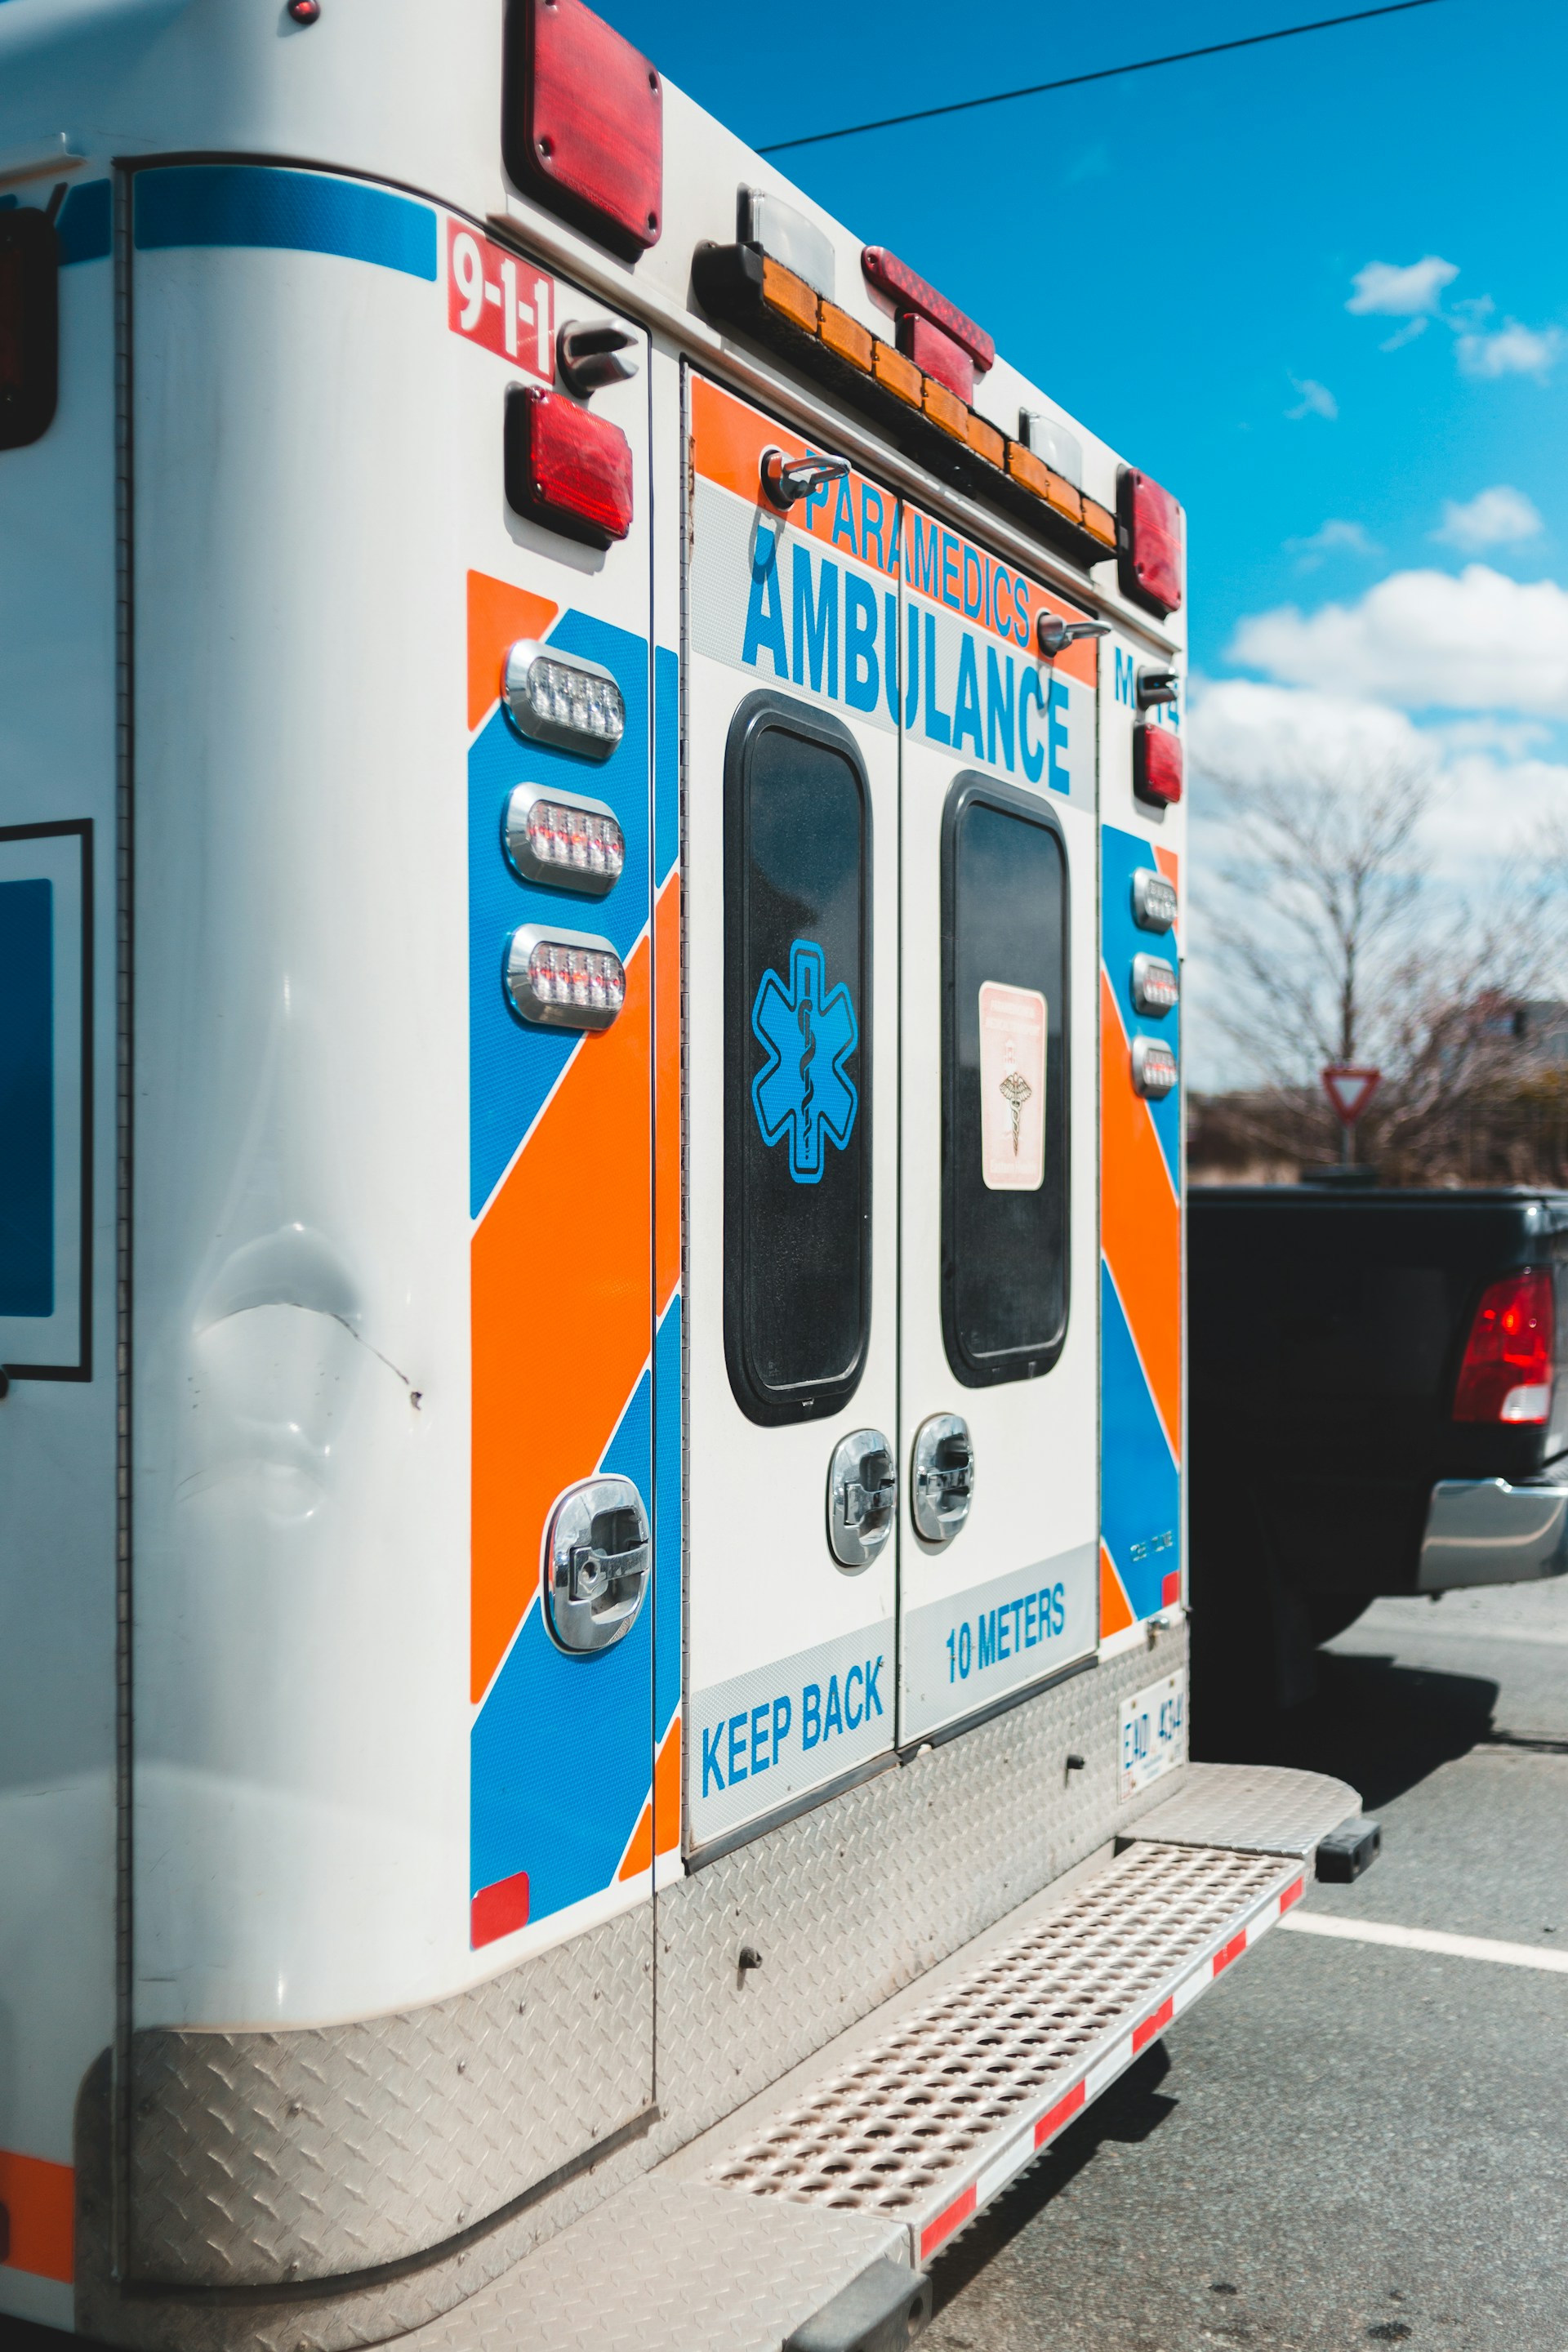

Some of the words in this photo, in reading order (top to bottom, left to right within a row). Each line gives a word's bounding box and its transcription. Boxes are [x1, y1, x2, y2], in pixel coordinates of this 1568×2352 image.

[452, 232, 550, 376] 9-1-1
[804, 448, 1030, 649] PARAMEDICS
[742, 524, 1071, 796] AMBULANCE
[946, 1621, 972, 1684] 10
[978, 1582, 1066, 1670] METERS
[702, 1695, 792, 1798] KEEP
[802, 1655, 884, 1752] BACK
